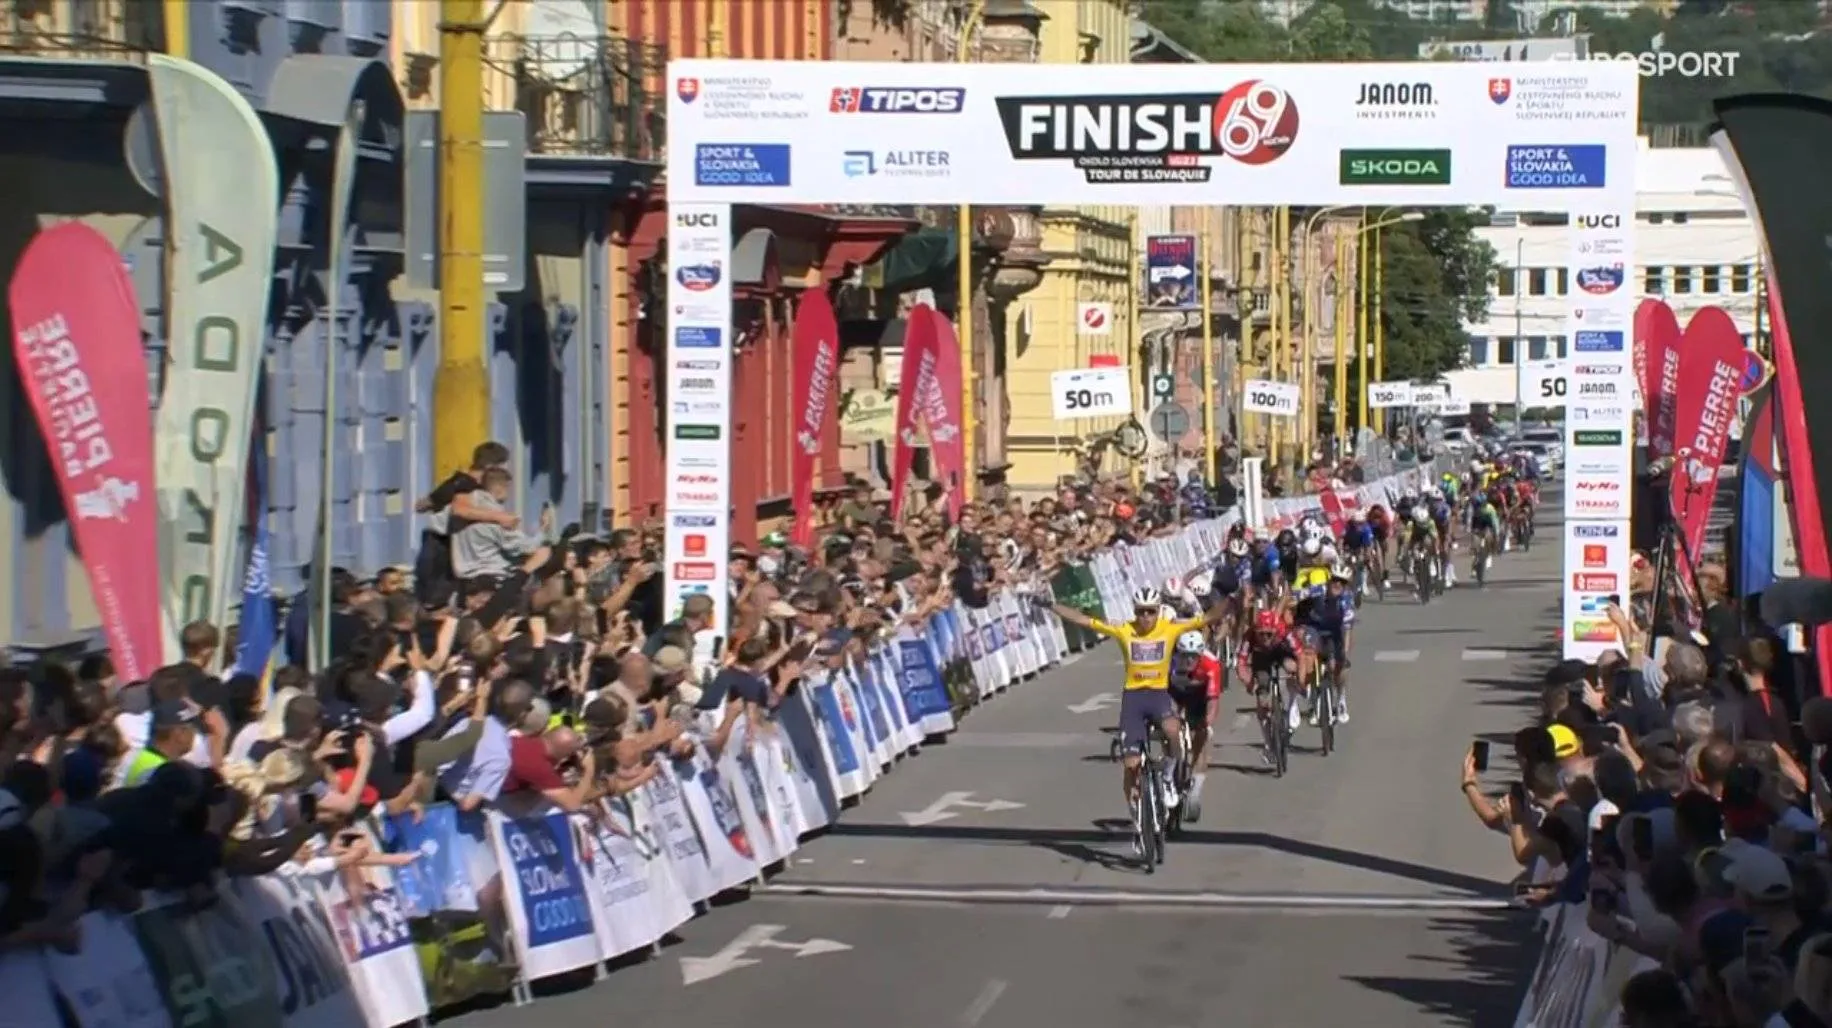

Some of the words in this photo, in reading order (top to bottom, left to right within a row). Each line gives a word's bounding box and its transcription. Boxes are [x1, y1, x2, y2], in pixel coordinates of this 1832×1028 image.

[866, 90, 959, 111] TIPOS
[1218, 80, 1287, 156] 69
[1356, 110, 1437, 119] INVESTMENTS
[1019, 104, 1212, 151] FINISH
[700, 147, 741, 159] SPORT
[744, 147, 755, 159] &
[884, 151, 951, 166] ALITER
[1510, 148, 1554, 160] SPORT
[1556, 148, 1569, 160] &
[700, 159, 761, 171] SLOVAKIA
[1078, 156, 1110, 166] OKOLO
[1111, 156, 1164, 166] SLOVENSKA
[1510, 161, 1574, 172] SLOVAKIA
[700, 172, 741, 184] GOOD
[743, 172, 774, 184] IDEA
[1089, 169, 1121, 180] TOUR
[1124, 169, 1140, 180] DE
[1142, 169, 1207, 182] SLOVAQUIE
[1510, 173, 1553, 185] GOOD
[1556, 173, 1588, 184] IDEA
[684, 213, 718, 227] UCI
[1585, 214, 1621, 229] UCI
[1065, 389, 1114, 409] 50m
[1250, 391, 1291, 409] 100m
[1695, 359, 1732, 454] PIERRE
